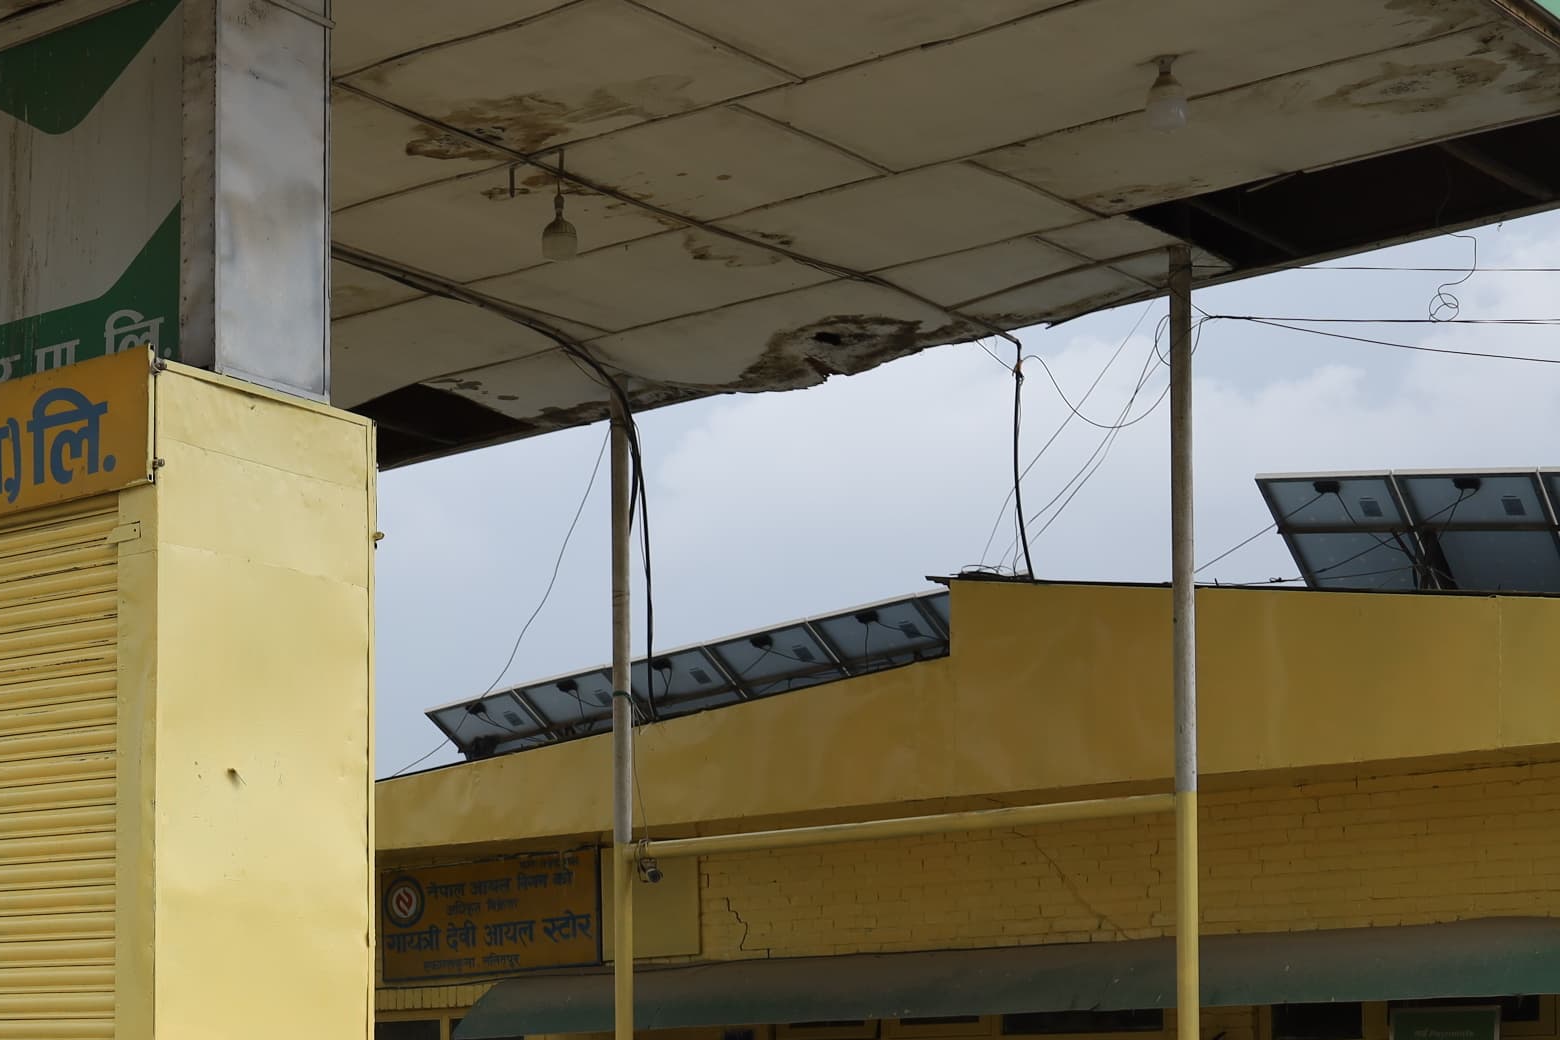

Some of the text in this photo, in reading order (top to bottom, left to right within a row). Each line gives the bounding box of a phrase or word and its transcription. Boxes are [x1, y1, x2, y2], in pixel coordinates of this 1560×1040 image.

[385, 909, 593, 953] गायत्री देवी आयल स्टोर
